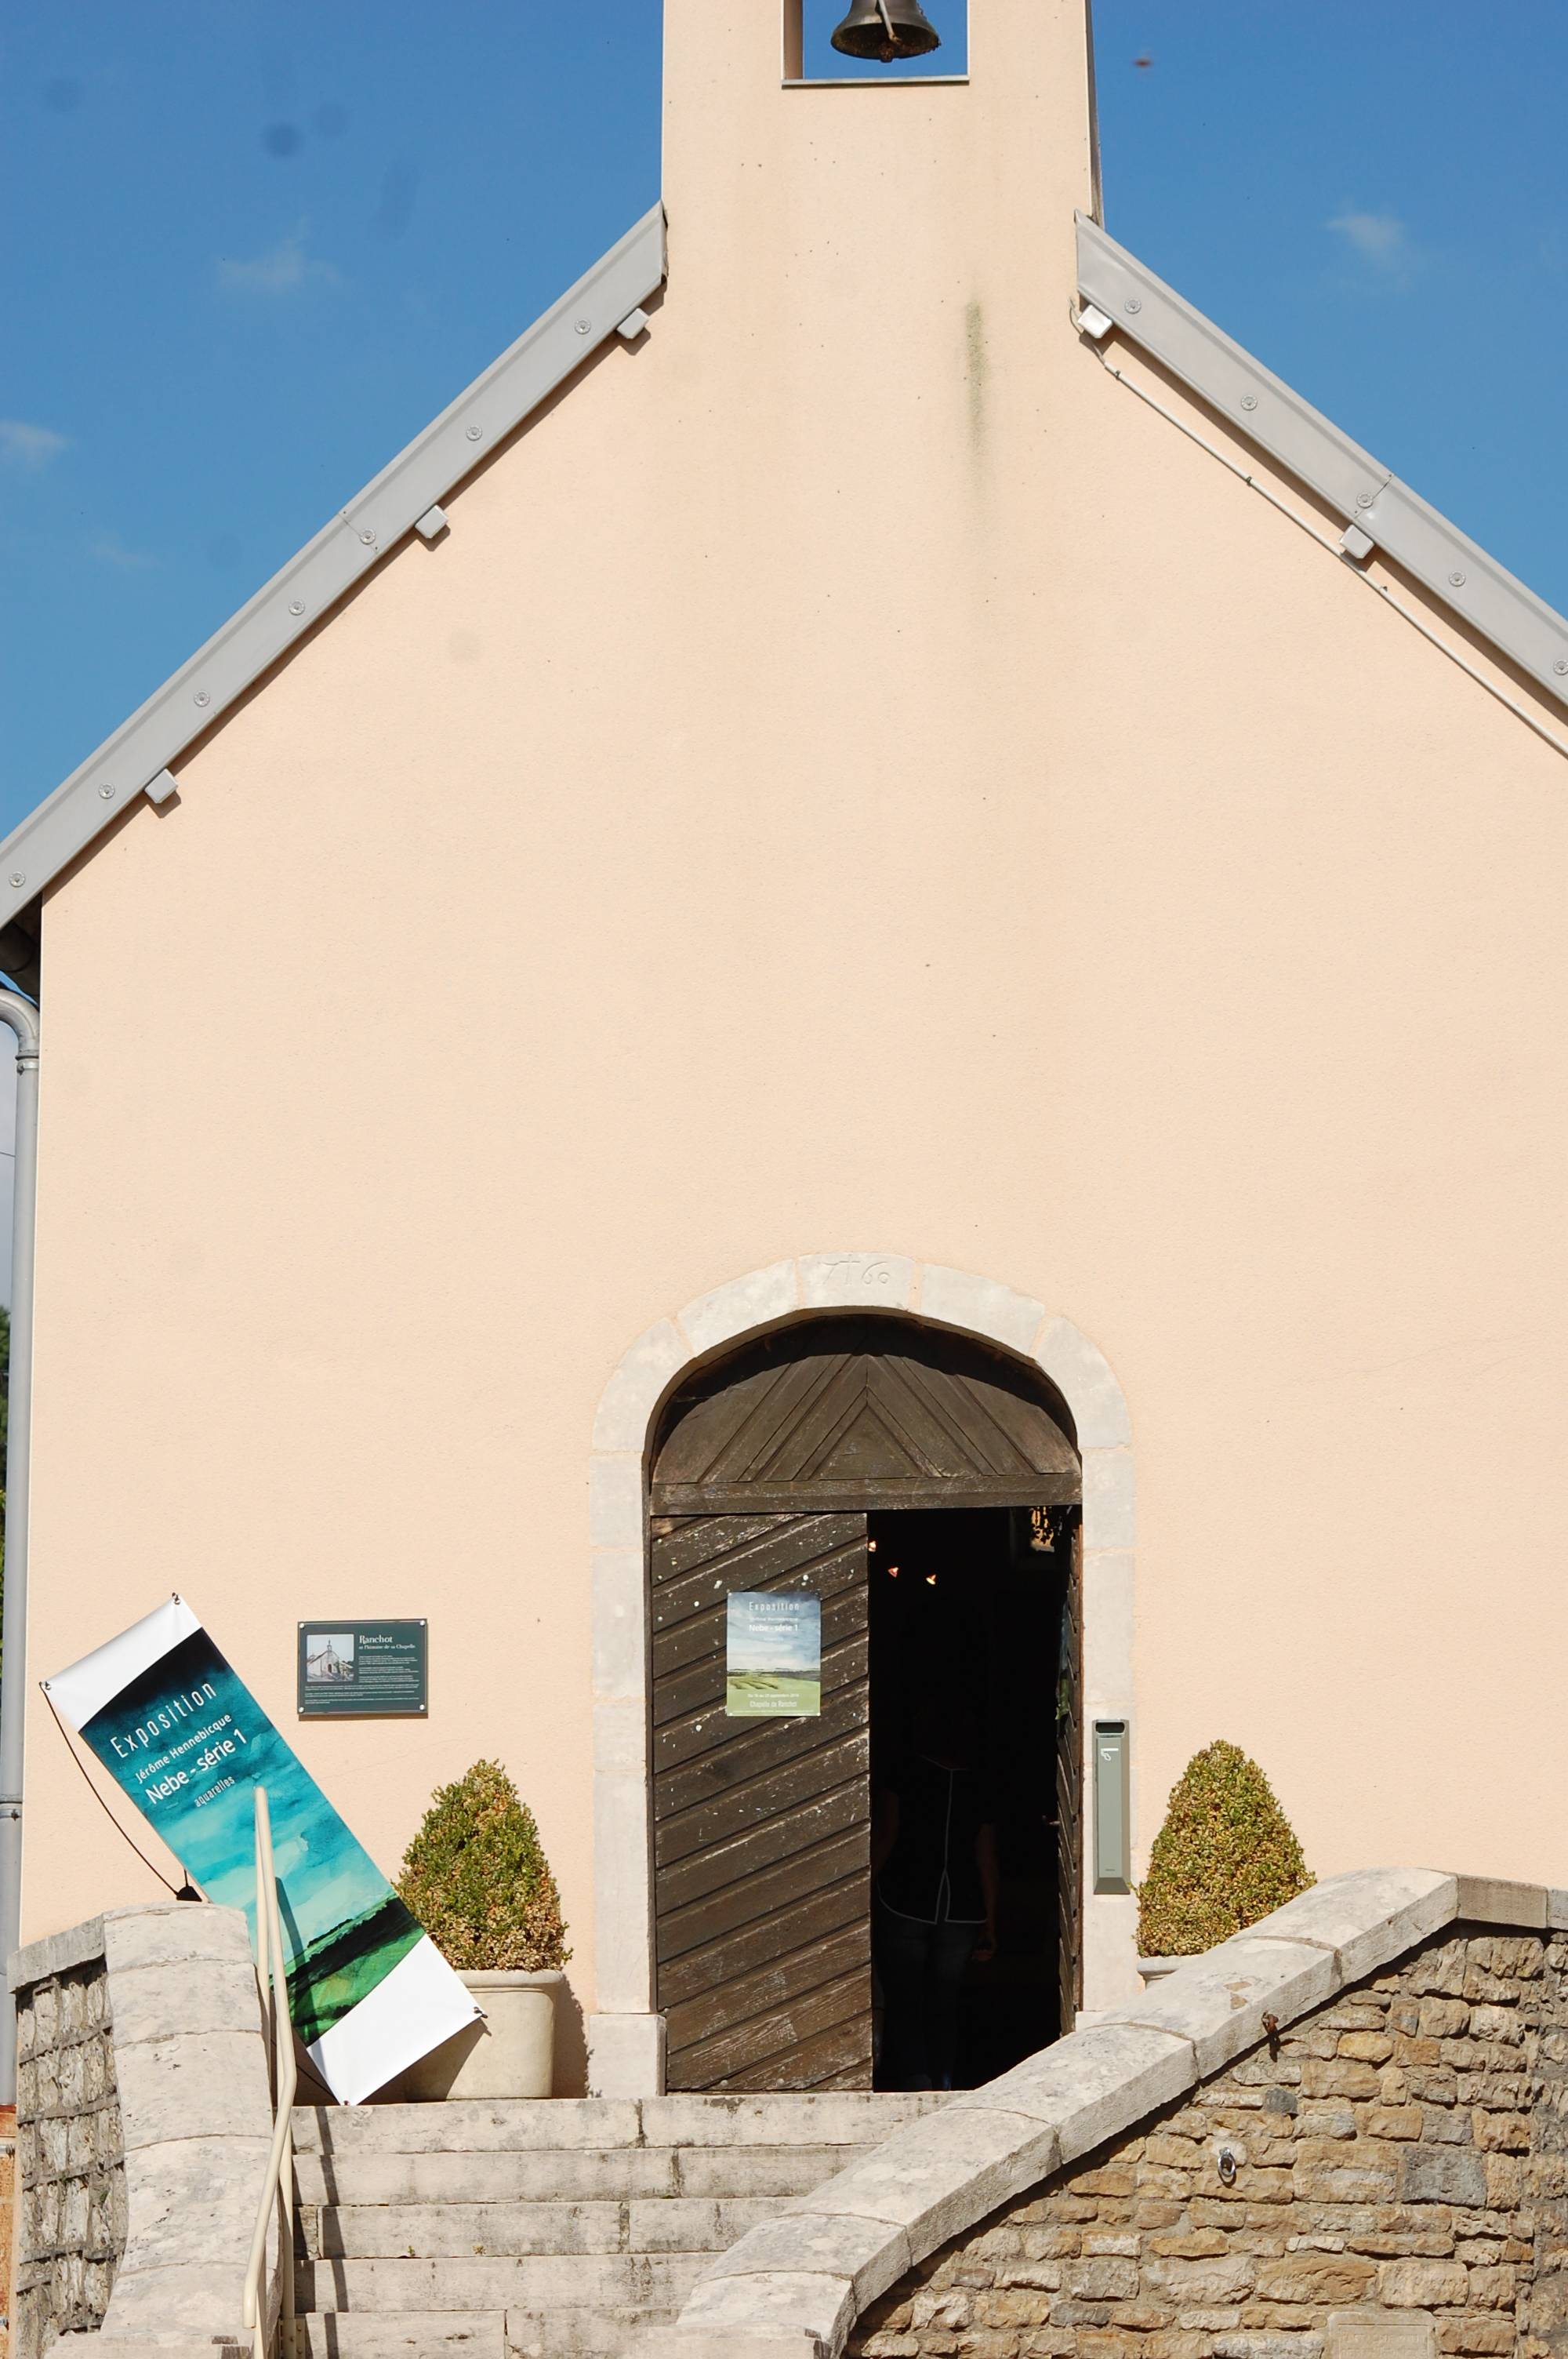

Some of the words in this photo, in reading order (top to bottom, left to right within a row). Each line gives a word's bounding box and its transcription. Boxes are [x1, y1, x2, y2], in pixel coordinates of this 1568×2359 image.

[749, 1601, 800, 1612] Exposition
[359, 1634, 393, 1645] Ranchot
[110, 1683, 216, 1758] Exposition
[135, 1755, 170, 1784] Jérôme
[169, 1714, 232, 1759] Hennebicque
[145, 1770, 190, 1805] Nebe
[197, 1739, 236, 1772] série
[234, 1728, 247, 1744] 1
[194, 1776, 235, 1808] aquarelles
